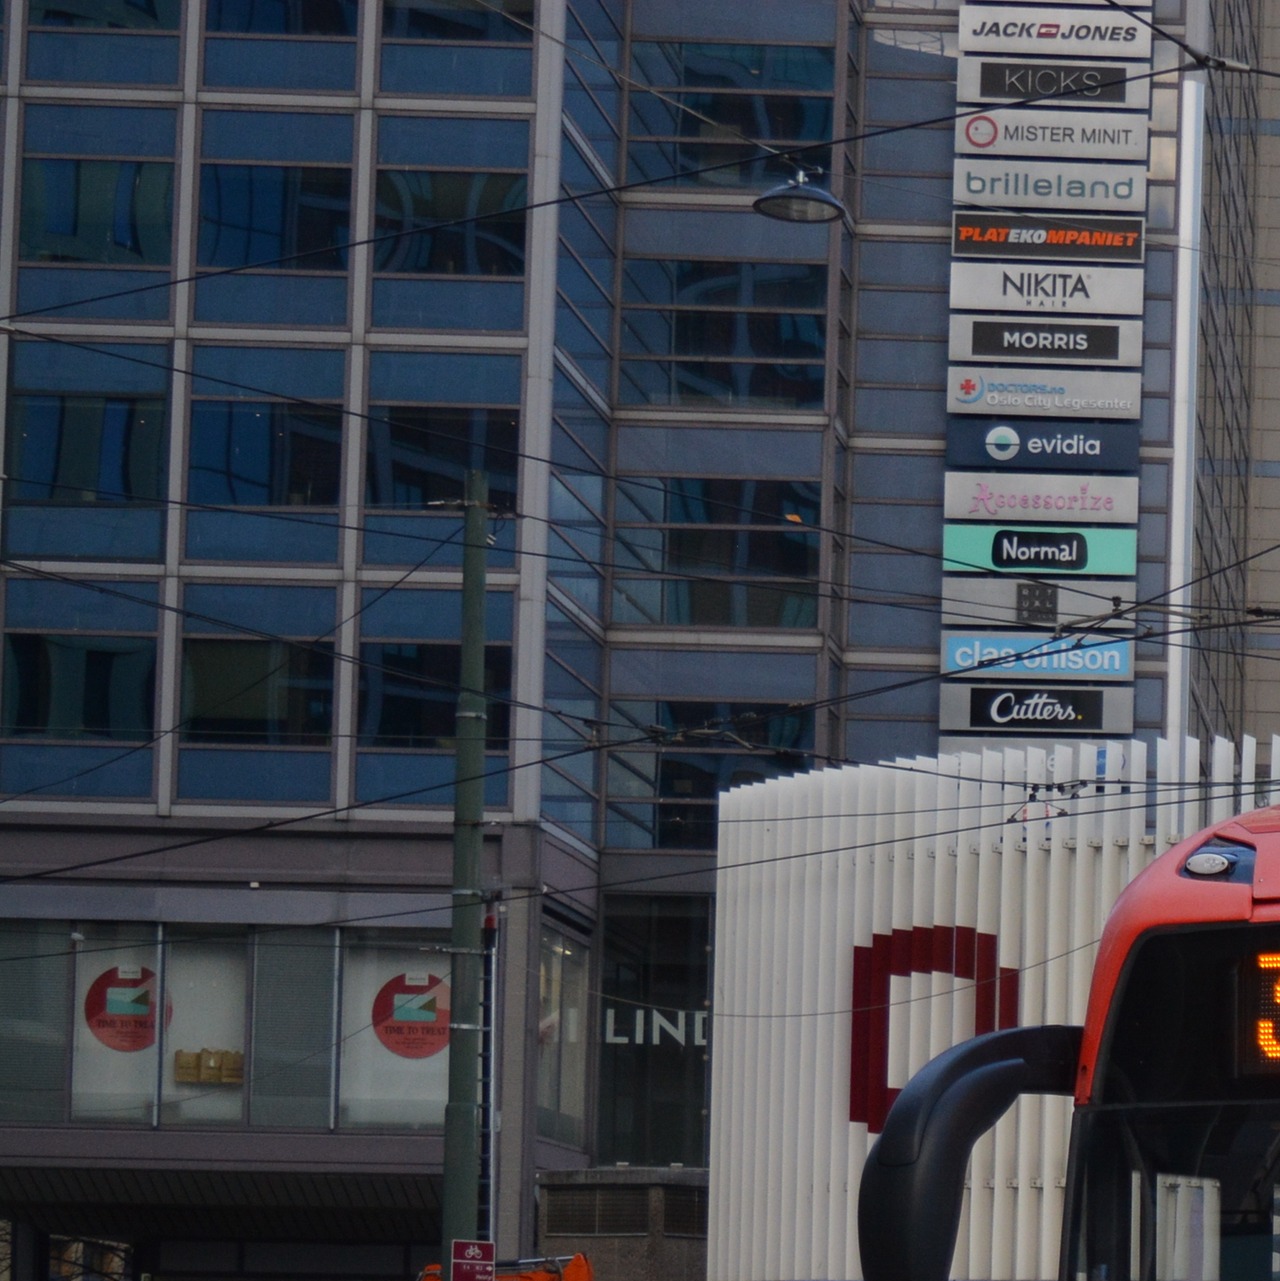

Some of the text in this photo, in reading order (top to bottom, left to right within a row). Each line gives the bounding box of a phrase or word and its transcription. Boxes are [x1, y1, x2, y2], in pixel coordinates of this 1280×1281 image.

[972, 22, 1137, 42] JACK JONES
[1005, 69, 1101, 97] KICKS
[1004, 124, 1133, 145] MISTER MINIT
[966, 171, 1134, 199] brilleland
[958, 227, 1139, 247] PLATEKOMPANIET
[1002, 271, 1090, 299] NIKITA
[1026, 300, 1067, 308] HAIR
[1003, 331, 1088, 350] MORRIS
[986, 394, 1132, 411] Oslo City Legesenter
[1027, 434, 1101, 456] evidia
[969, 482, 1114, 515] Accessorize
[1002, 537, 1078, 562] Normal
[955, 641, 1121, 670] clas ohlson
[990, 692, 1083, 723] Cutters.
